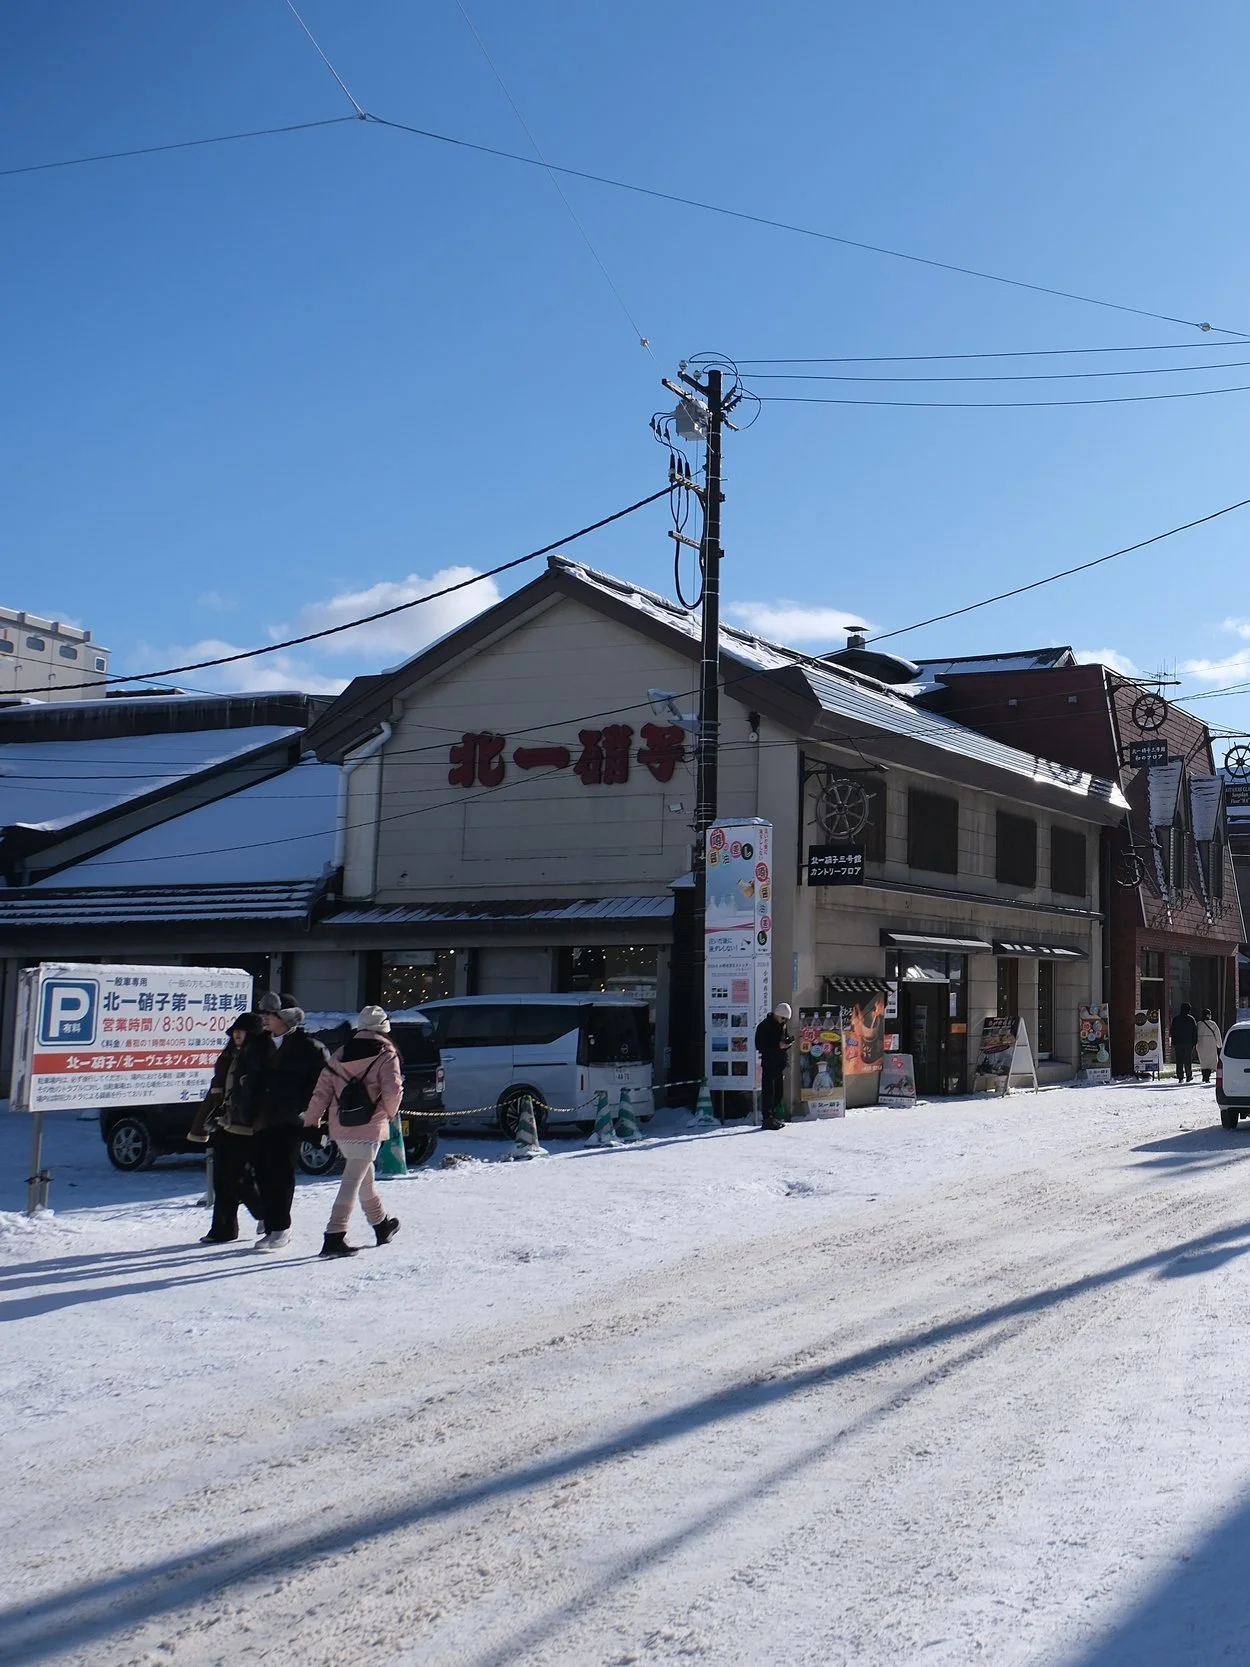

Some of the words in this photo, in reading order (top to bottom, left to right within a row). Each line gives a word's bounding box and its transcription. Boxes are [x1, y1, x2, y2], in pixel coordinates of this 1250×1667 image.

[448, 723, 685, 788] 北一硝子
[810, 866, 861, 876] カントリーフロア
[106, 976, 148, 987] 一般車専用
[103, 991, 248, 1012] 北一硝子第一駐車場
[49, 987, 90, 1037] P
[63, 1022, 81, 1033] 有料
